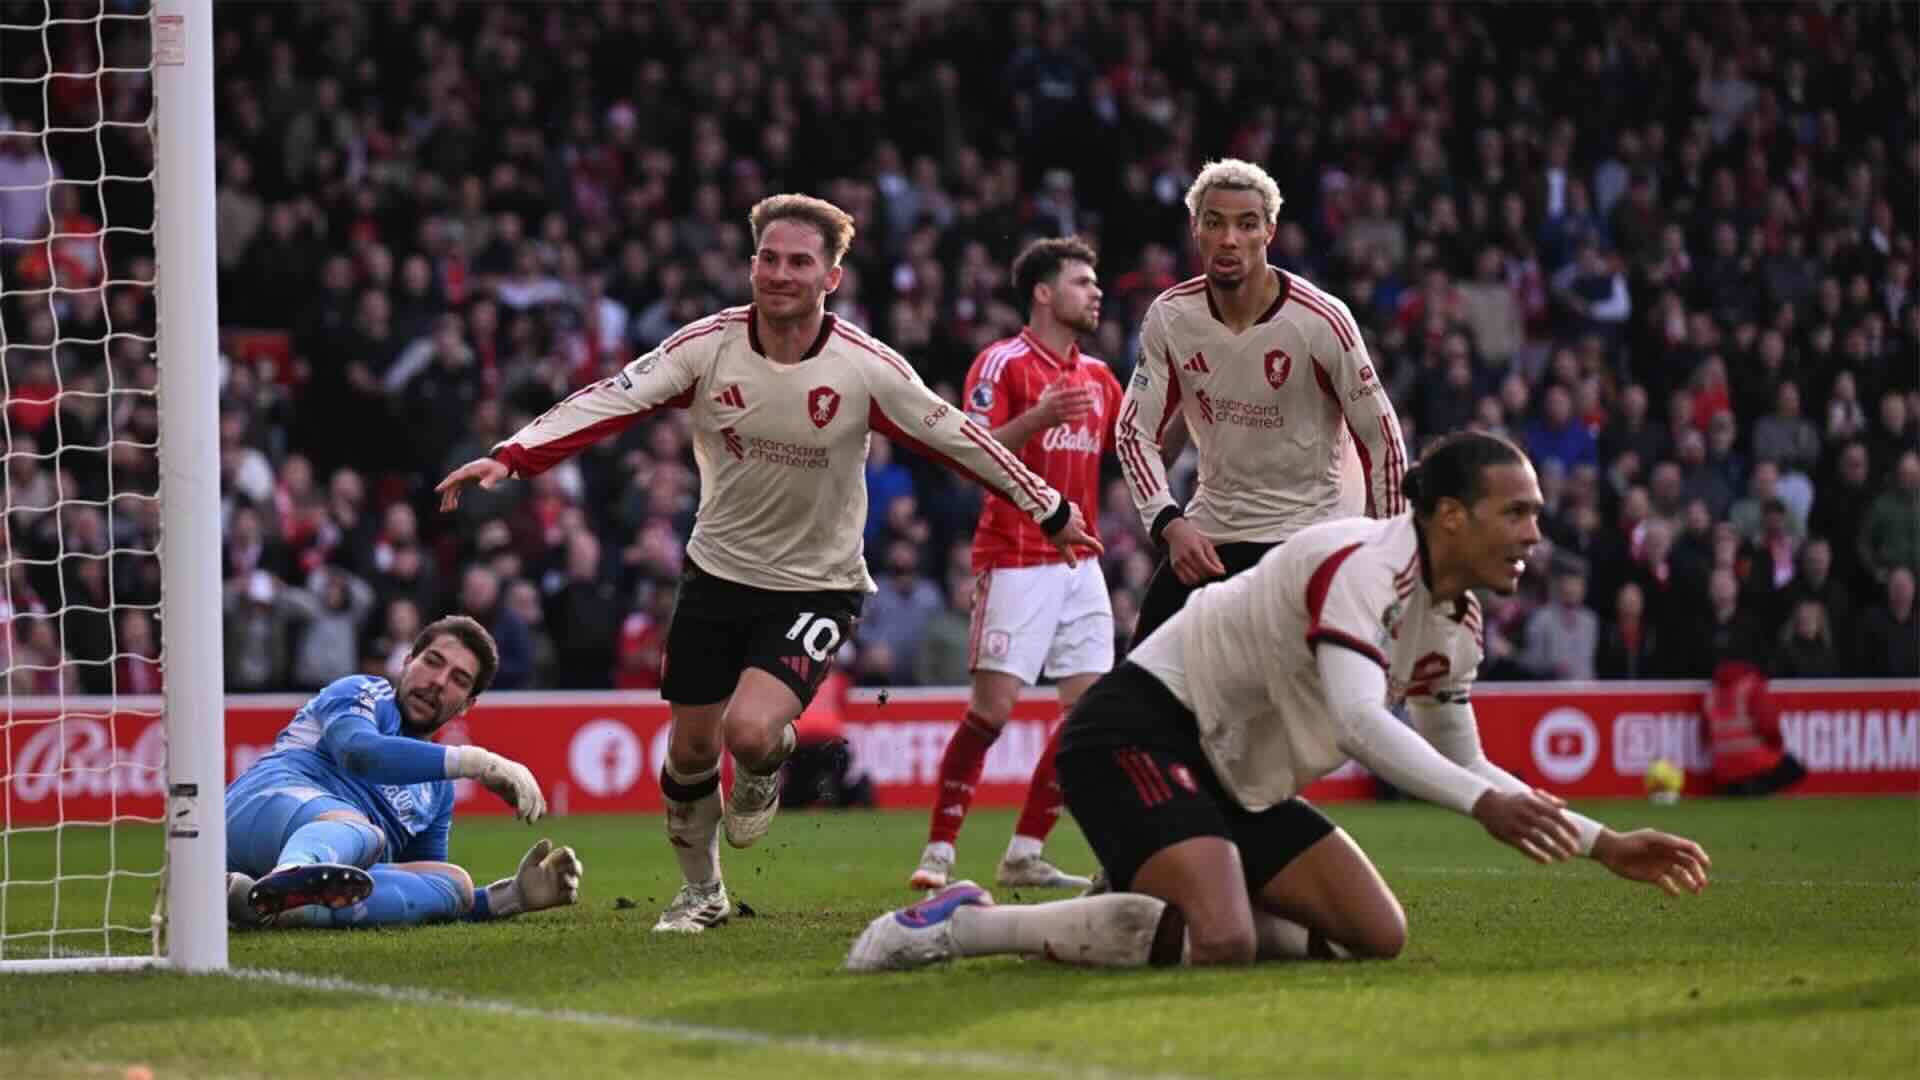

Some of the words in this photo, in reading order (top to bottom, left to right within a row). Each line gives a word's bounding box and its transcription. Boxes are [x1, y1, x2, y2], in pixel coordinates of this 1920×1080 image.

[1215, 398, 1279, 417] standard
[1215, 410, 1284, 429] chartered
[750, 437, 827, 457] standard
[750, 447, 829, 469] chartered
[785, 612, 840, 662] 10
